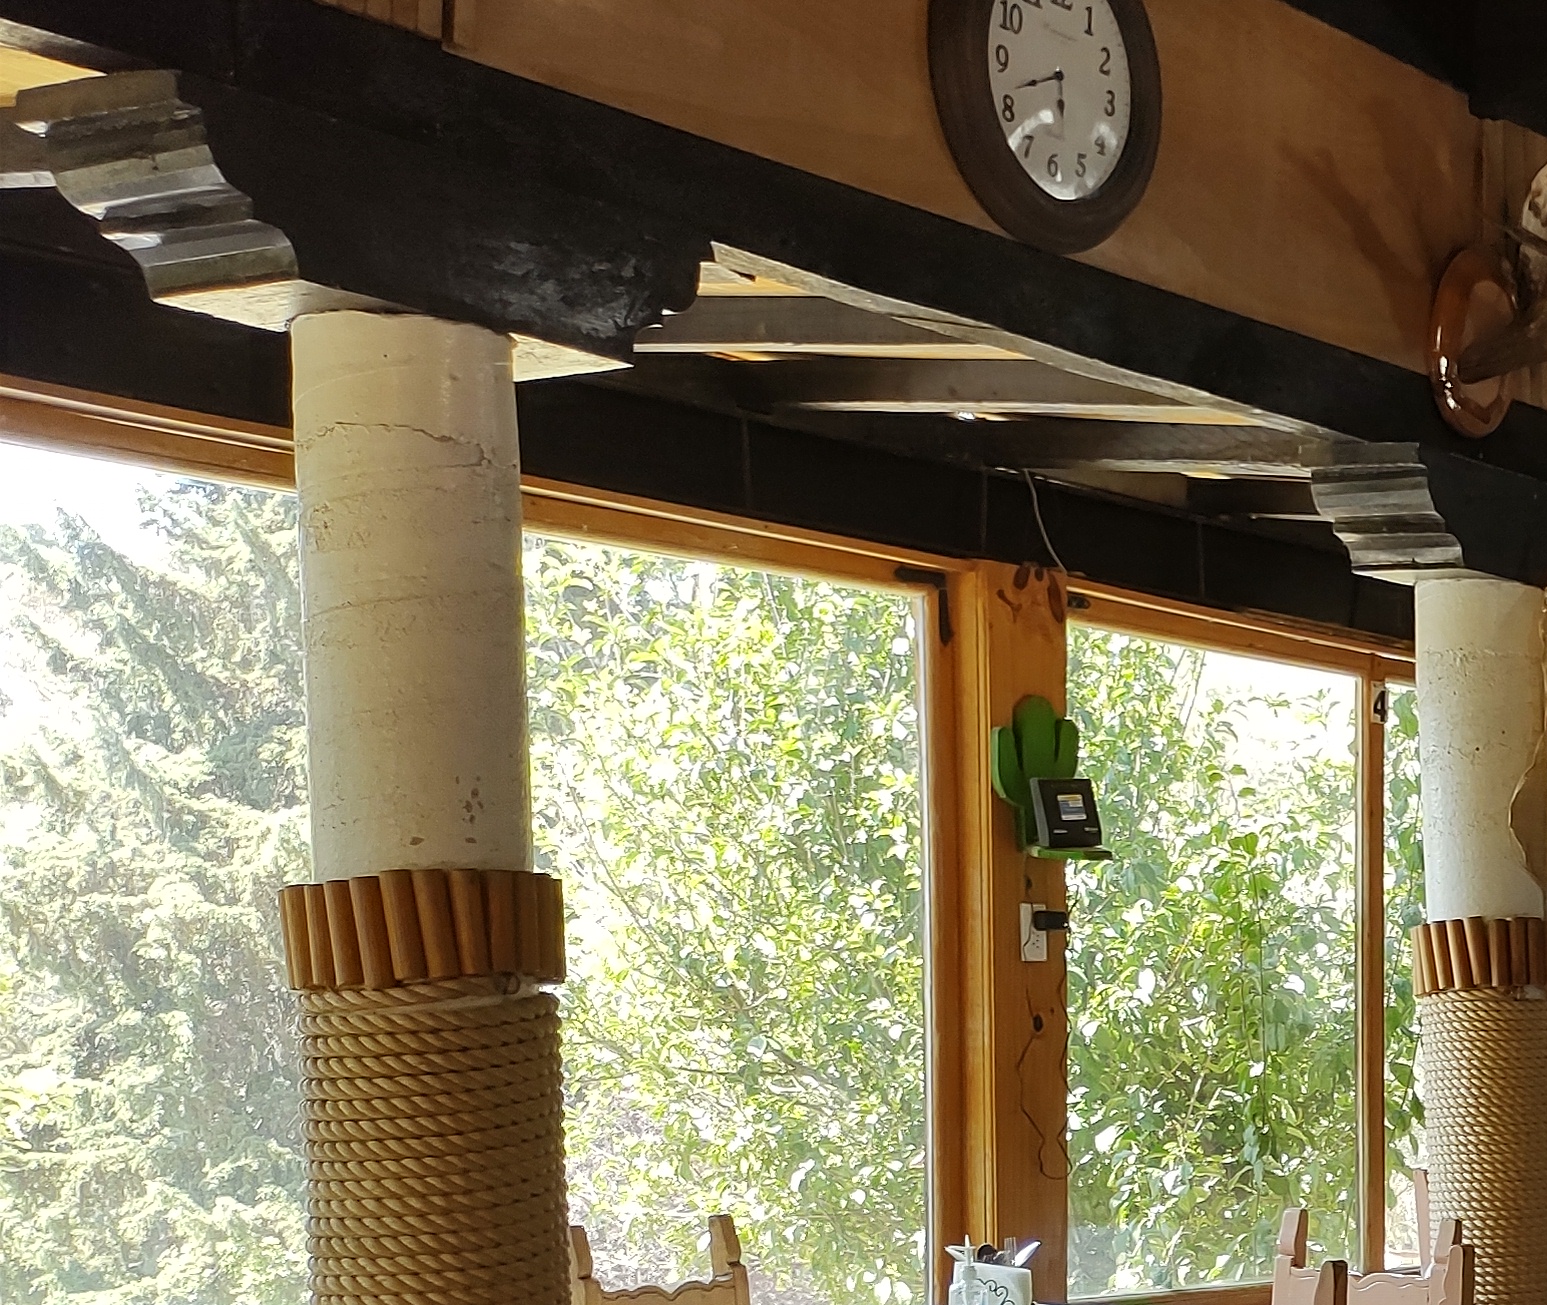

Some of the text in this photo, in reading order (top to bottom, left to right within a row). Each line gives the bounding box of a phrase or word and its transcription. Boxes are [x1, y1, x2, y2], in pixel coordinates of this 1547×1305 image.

[1000, 0, 1022, 34] 10
[1084, 6, 1093, 36] 1
[995, 44, 1009, 72] 9
[1099, 47, 1111, 76] 2
[1002, 94, 1014, 122] 8
[1104, 90, 1115, 116] 3
[1022, 134, 1034, 158] 7
[1047, 153, 1058, 177] 6
[1075, 153, 1086, 177] 5
